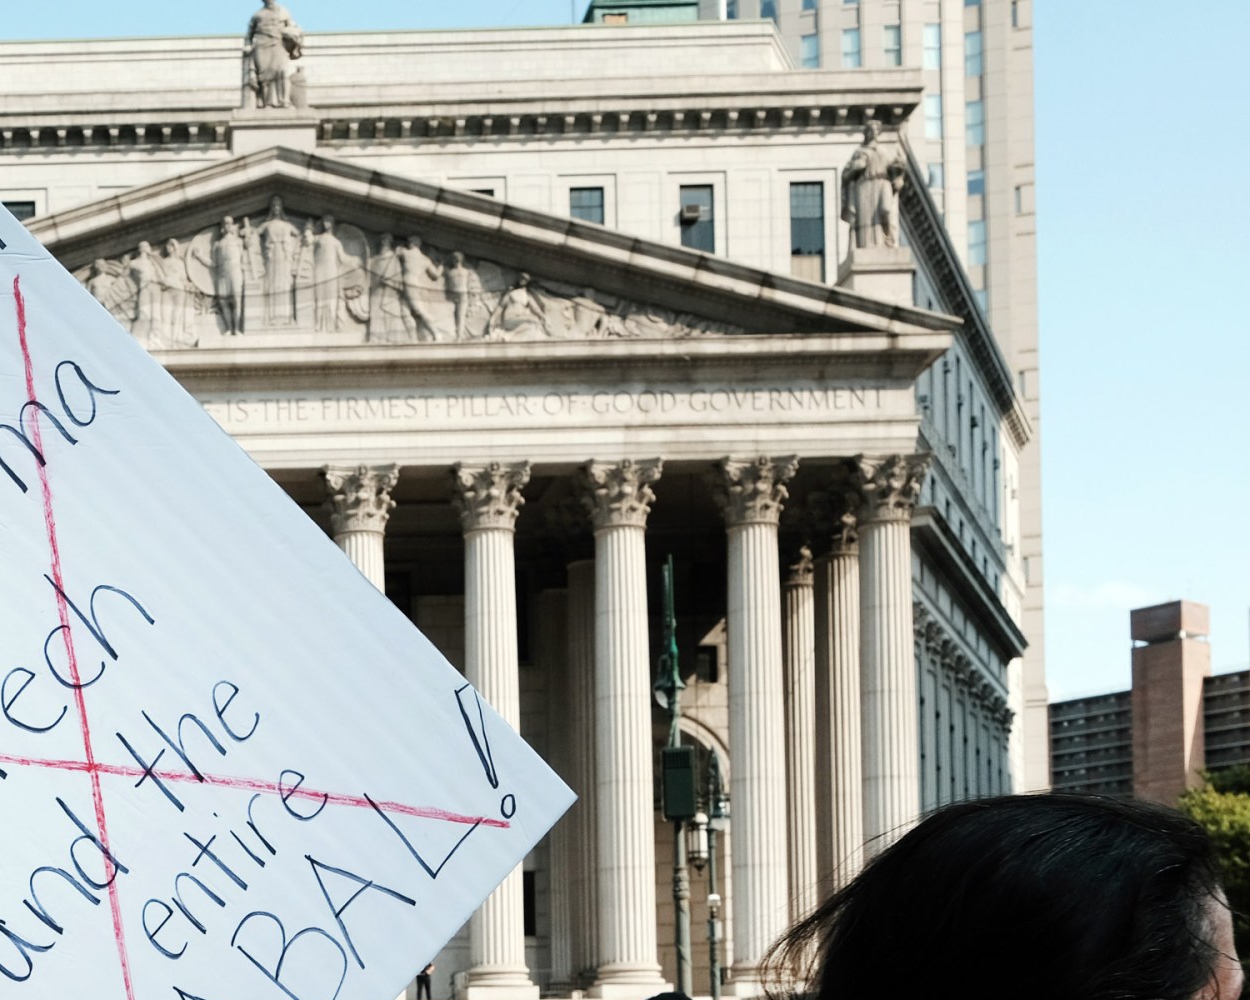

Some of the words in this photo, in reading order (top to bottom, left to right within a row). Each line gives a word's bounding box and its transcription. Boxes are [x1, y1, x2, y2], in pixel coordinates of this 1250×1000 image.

[225, 398, 249, 423] IS
[254, 397, 309, 422] THE
[320, 394, 435, 421] FIRMEST
[445, 392, 535, 418] PILLAR
[541, 390, 581, 416] OF
[590, 388, 676, 415] GOOD
[687, 384, 887, 412] GOVERNMENT
[115, 680, 260, 812] the
[141, 769, 328, 960] entire
